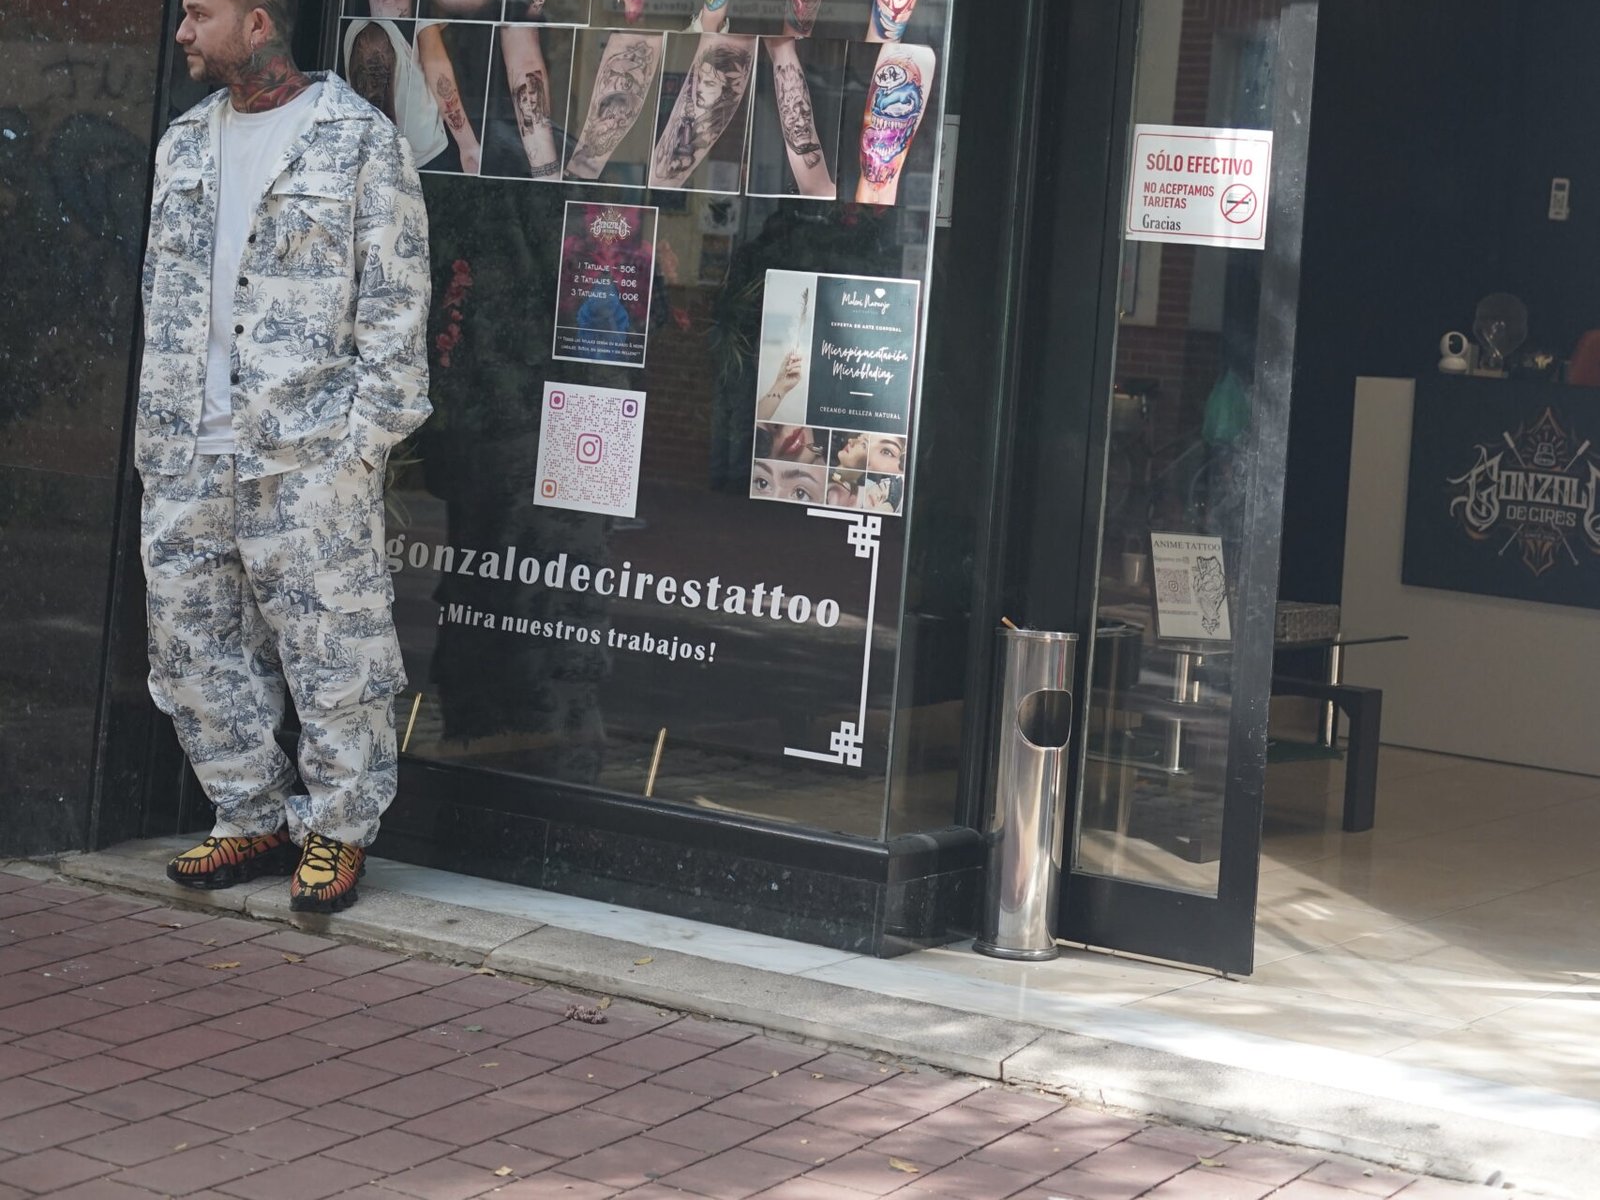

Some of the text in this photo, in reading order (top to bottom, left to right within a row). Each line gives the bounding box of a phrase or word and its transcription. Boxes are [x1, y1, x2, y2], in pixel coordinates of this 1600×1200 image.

[1146, 149, 1253, 176] SÓLO EFECTIVO
[1143, 181, 1215, 197] NO ACEPTAMOS
[1143, 195, 1187, 209] TARJETAS
[1142, 213, 1181, 231] Gracias
[820, 406, 901, 420] CREANDO BELLEZA NATURAL
[1153, 540, 1221, 551] ANIME TATTOO
[385, 534, 841, 628] gonzalodecirestattoo
[437, 602, 717, 663] ¡Mira nuestros trabajos!
